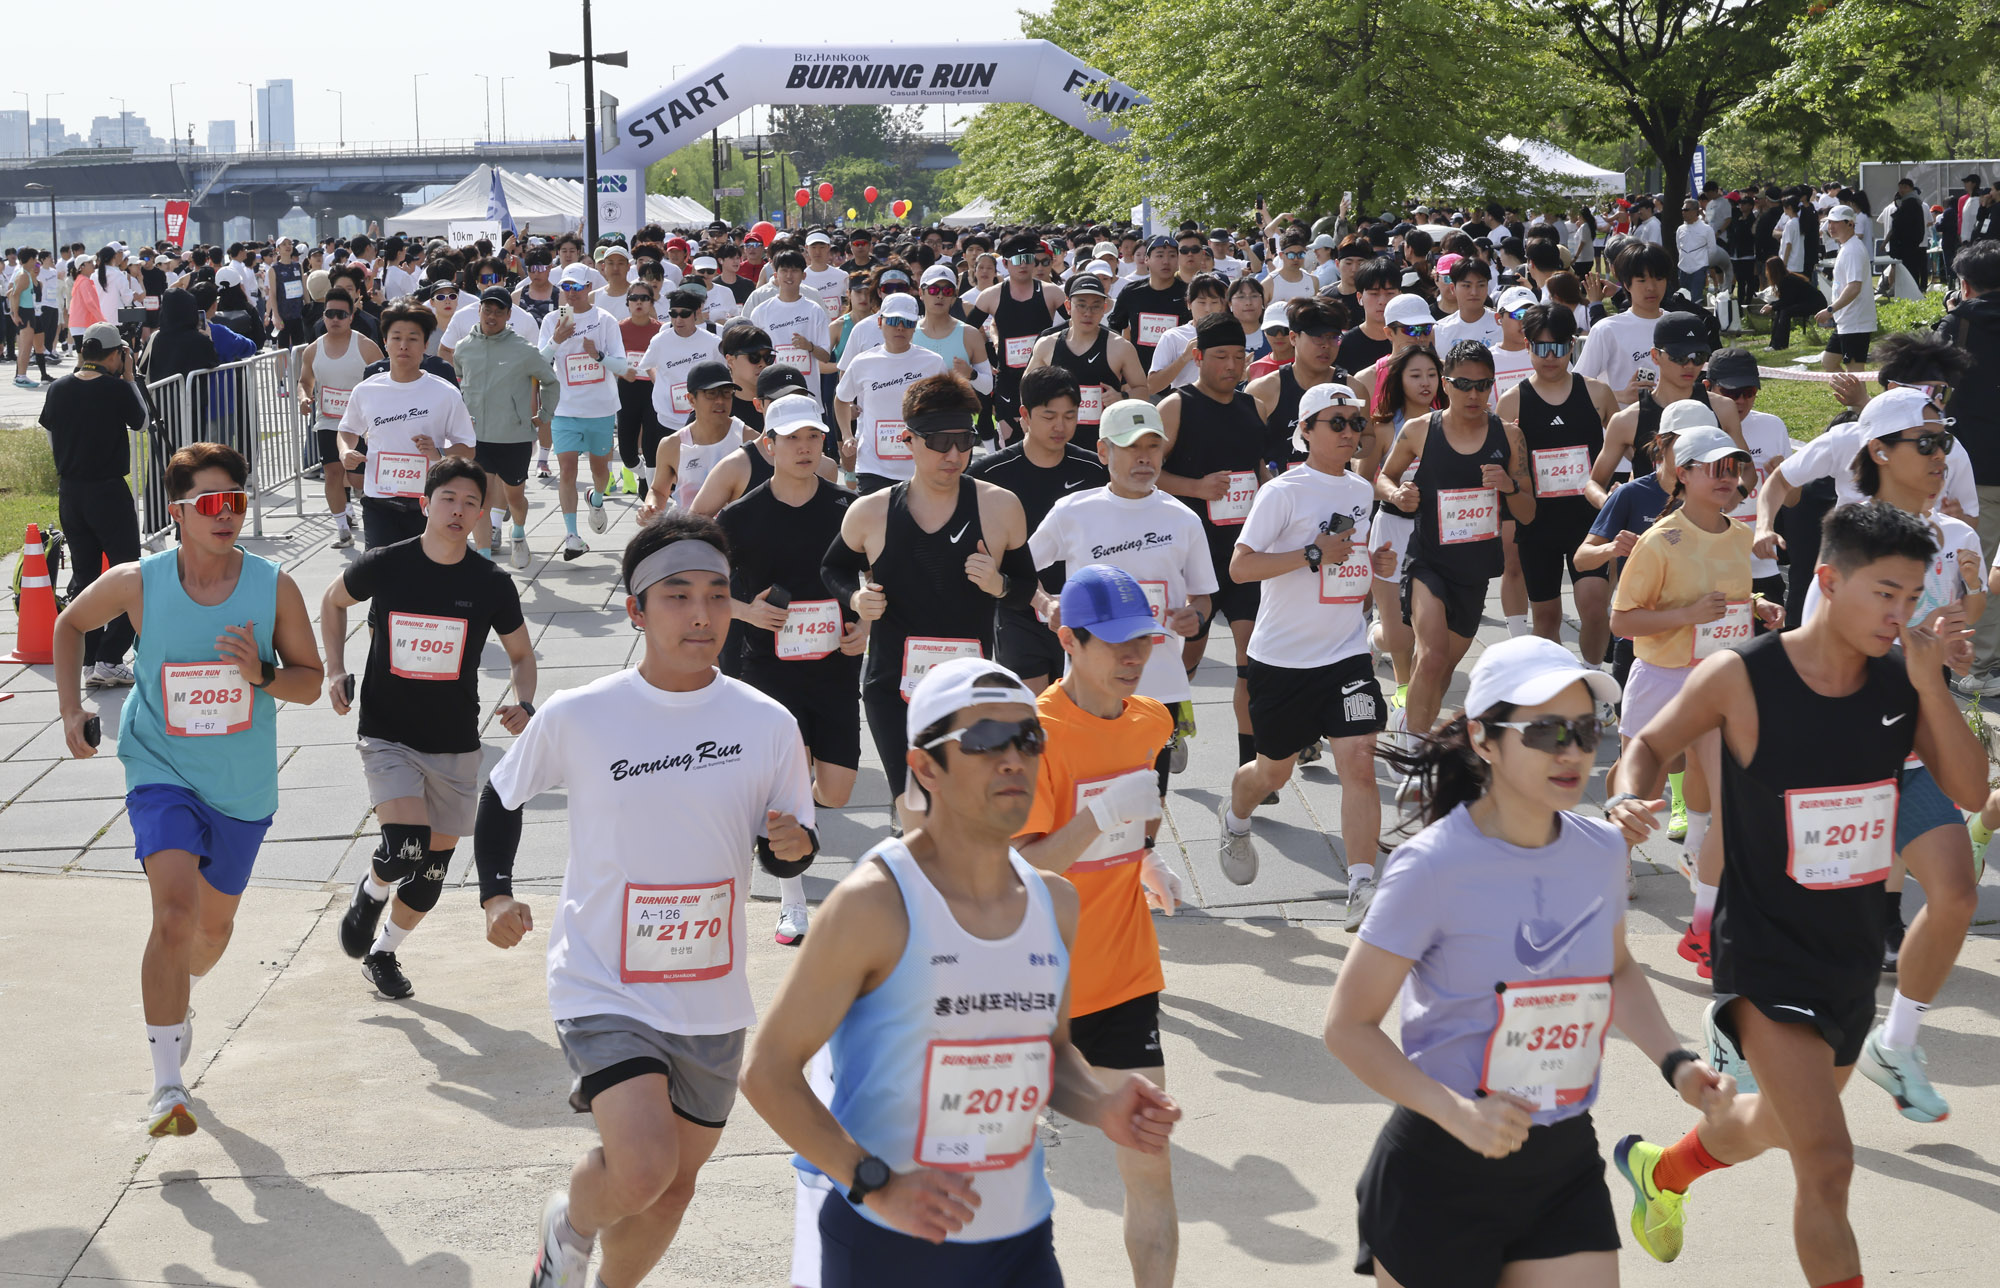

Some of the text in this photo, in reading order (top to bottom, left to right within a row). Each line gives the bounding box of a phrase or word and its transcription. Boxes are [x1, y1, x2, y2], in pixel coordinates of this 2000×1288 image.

[785, 62, 998, 89] BURNING RUN
[920, 89, 955, 97] Running
[1062, 69, 1141, 113] FINI
[627, 72, 731, 149] START
[452, 231, 497, 241] 10km 7km
[770, 316, 810, 332] Burning Run
[1150, 326, 1167, 334] 180
[1016, 347, 1032, 356] 129
[666, 352, 706, 368] Burning Run
[577, 363, 600, 372] 1185
[872, 372, 922, 391] Burning Run
[1080, 400, 1098, 408] 282
[374, 408, 429, 427] Burning Run
[890, 435, 902, 443] 19
[392, 468, 421, 480] 1824
[1542, 464, 1584, 476] M 2413
[1226, 490, 1254, 502] 1377
[1457, 506, 1494, 520] 2407
[1091, 532, 1173, 559] Burning Run
[1328, 564, 1368, 578] M 2036
[396, 620, 424, 628] BURNING
[424, 622, 439, 630] RUN
[784, 620, 836, 636] M 1426
[1702, 624, 1748, 638] W 3513
[396, 638, 454, 654] M 1905
[912, 644, 944, 652] BURNING
[170, 670, 204, 678] BURNING
[914, 664, 925, 674] M
[174, 688, 242, 705] M 2083
[194, 722, 215, 730] F-67
[610, 740, 743, 781] Burning Run
[1804, 819, 1885, 846] M 2015
[635, 896, 679, 904] BURNING
[680, 894, 702, 904] RUN
[640, 909, 680, 920] A-126
[636, 917, 722, 941] M 2170
[670, 946, 692, 956] 한상범
[934, 992, 1056, 1017] 홍성내포러닝크루
[1506, 1022, 1595, 1052] W 3261
[940, 1053, 991, 1066] BURNING
[994, 1052, 1014, 1064] RUN
[940, 1086, 1039, 1115] M 2019
